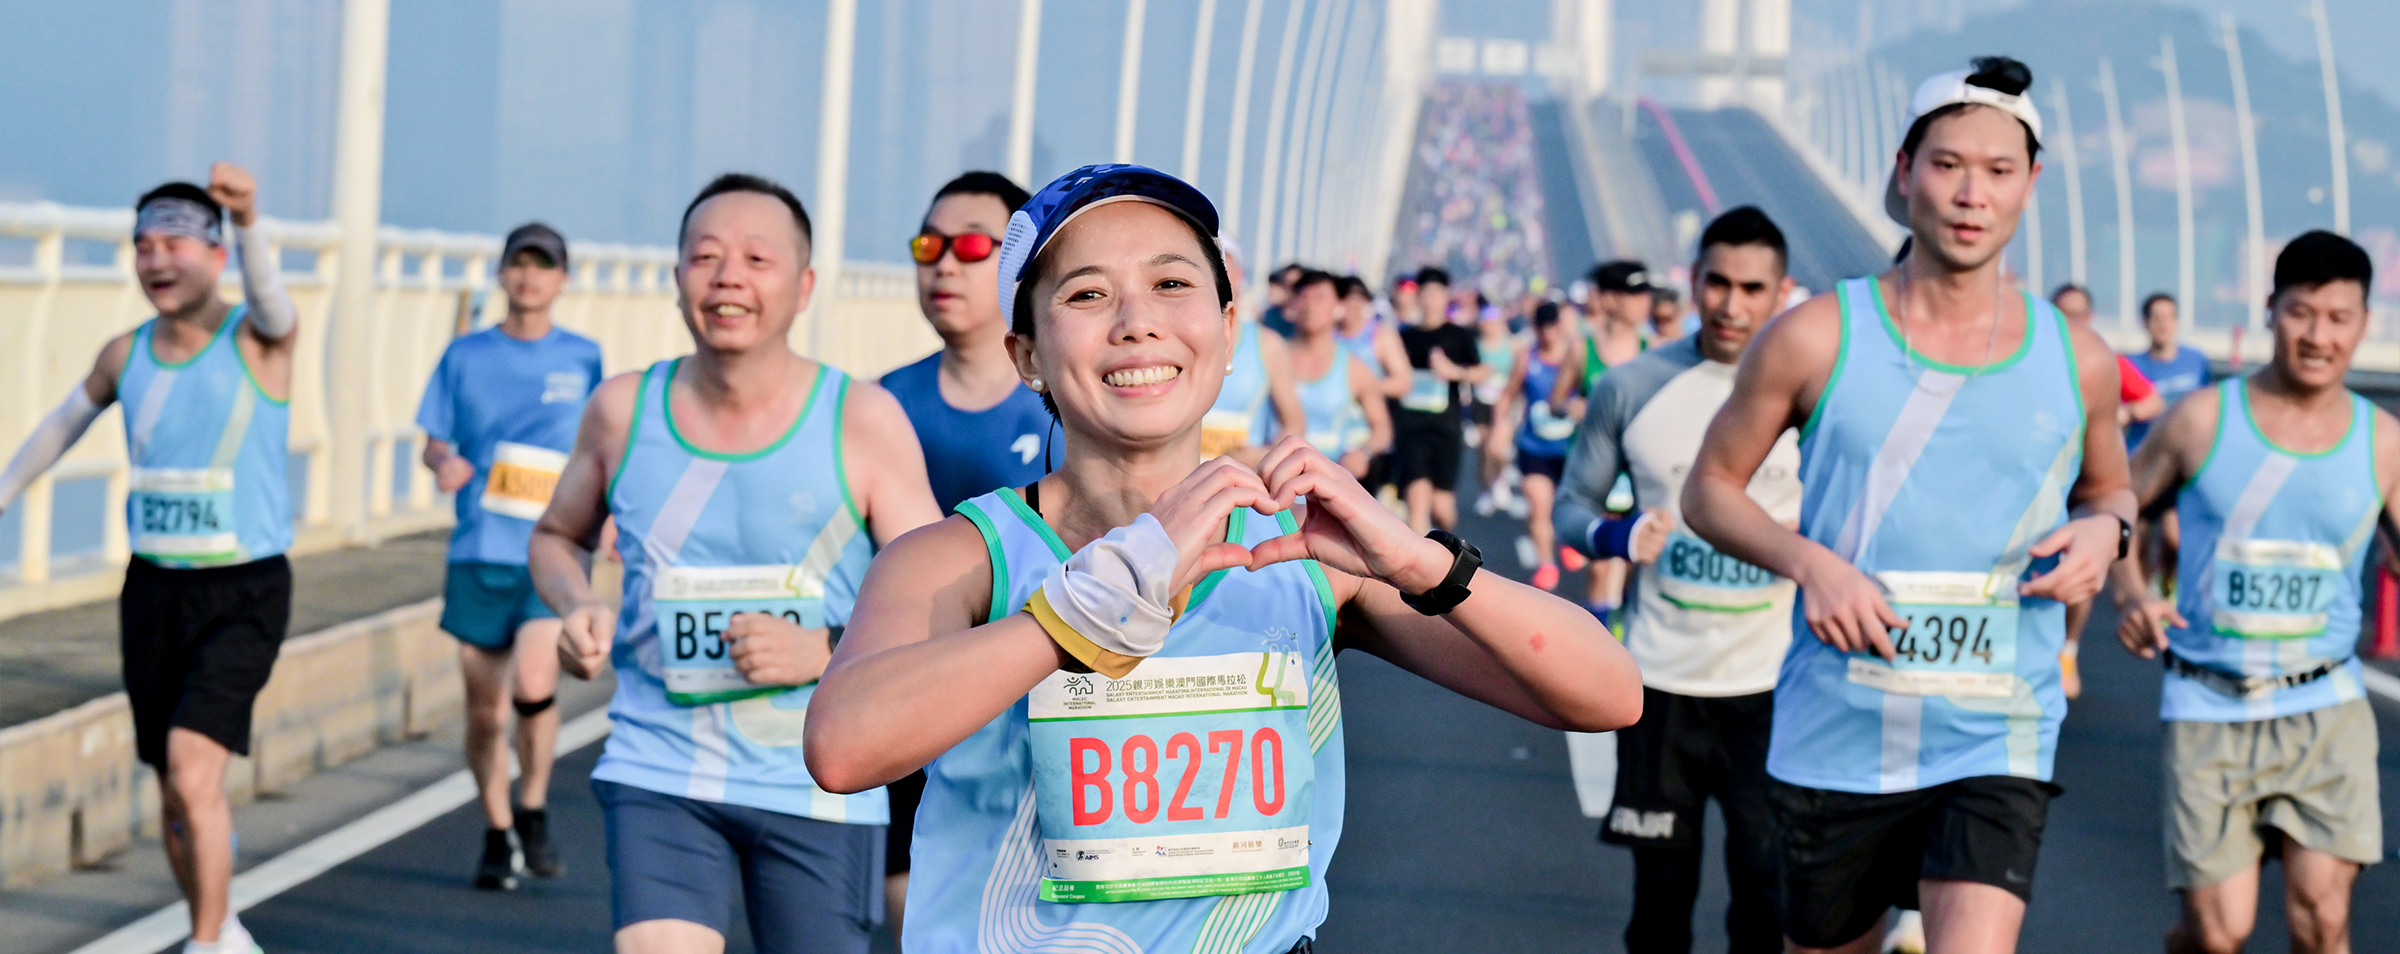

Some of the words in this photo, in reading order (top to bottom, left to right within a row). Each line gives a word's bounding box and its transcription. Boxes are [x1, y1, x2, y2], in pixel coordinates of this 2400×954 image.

[2228, 570, 2321, 610] B5287
[1869, 615, 1993, 664] 4394
[1069, 727, 1285, 826] B8270
